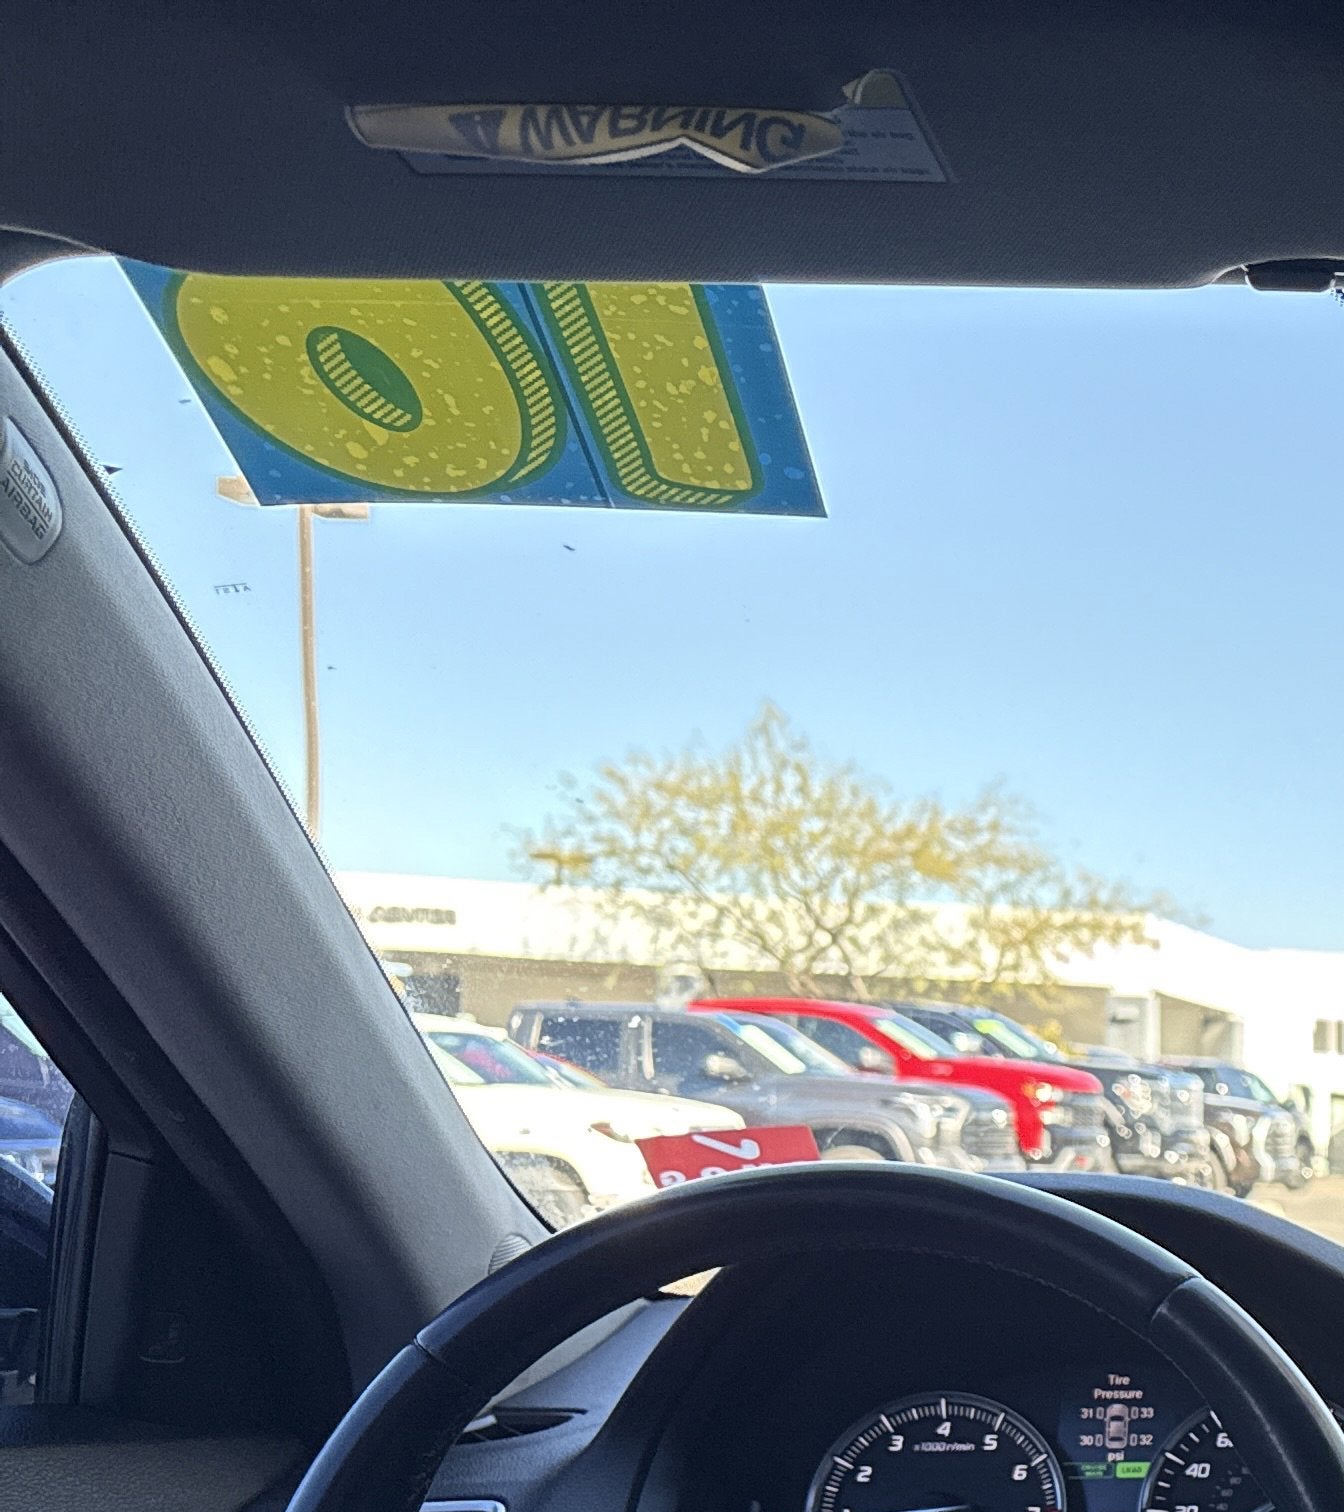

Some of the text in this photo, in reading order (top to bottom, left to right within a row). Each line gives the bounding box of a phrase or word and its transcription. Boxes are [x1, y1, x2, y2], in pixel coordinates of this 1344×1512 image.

[1107, 1373, 1130, 1386] Tire
[1092, 1388, 1144, 1401] Pressure
[1080, 1407, 1094, 1419] 31
[1139, 1406, 1155, 1419] 33
[935, 1420, 953, 1438] 4
[887, 1434, 905, 1453] 3
[983, 1433, 999, 1452] 5
[1079, 1434, 1094, 1447] 30
[1139, 1434, 1154, 1447] 32
[1107, 1450, 1125, 1464] psi
[856, 1464, 874, 1483] 2
[1011, 1463, 1029, 1482] 6
[1184, 1461, 1212, 1480] 40
